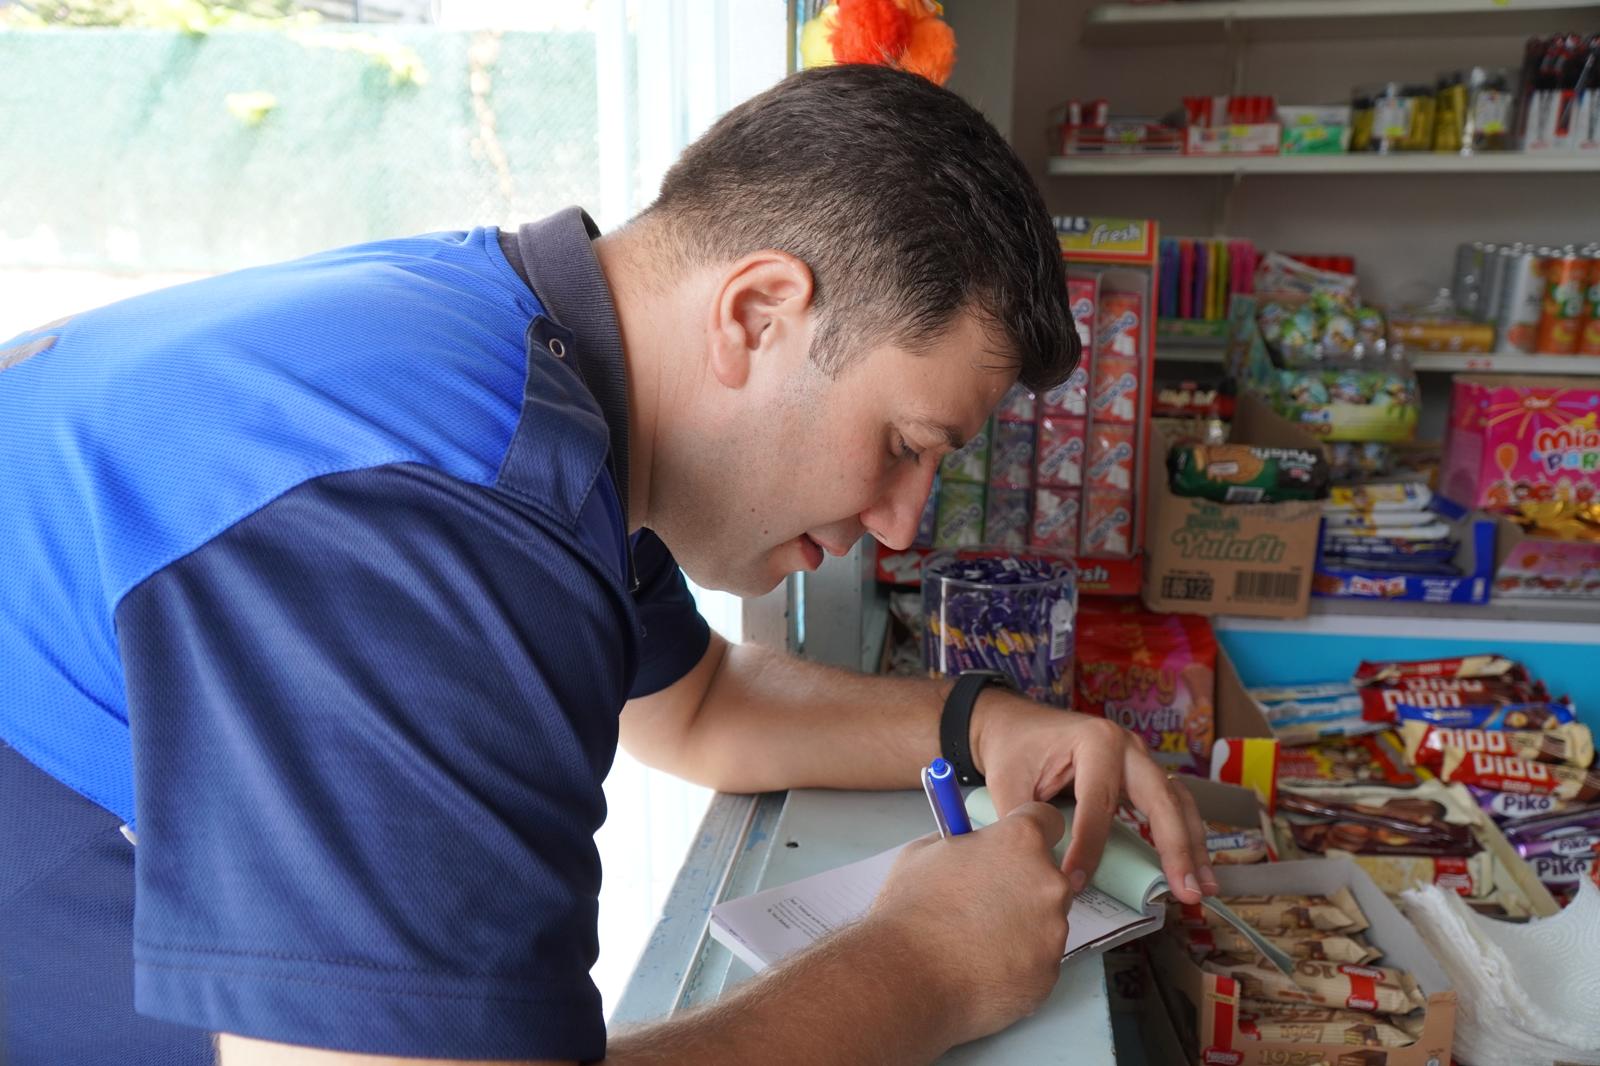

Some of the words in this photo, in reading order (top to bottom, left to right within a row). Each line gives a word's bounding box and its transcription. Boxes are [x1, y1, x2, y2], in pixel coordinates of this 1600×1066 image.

[1091, 222, 1141, 248] fresh
[1503, 795, 1551, 811] Piko
[1536, 858, 1587, 878] Piko
